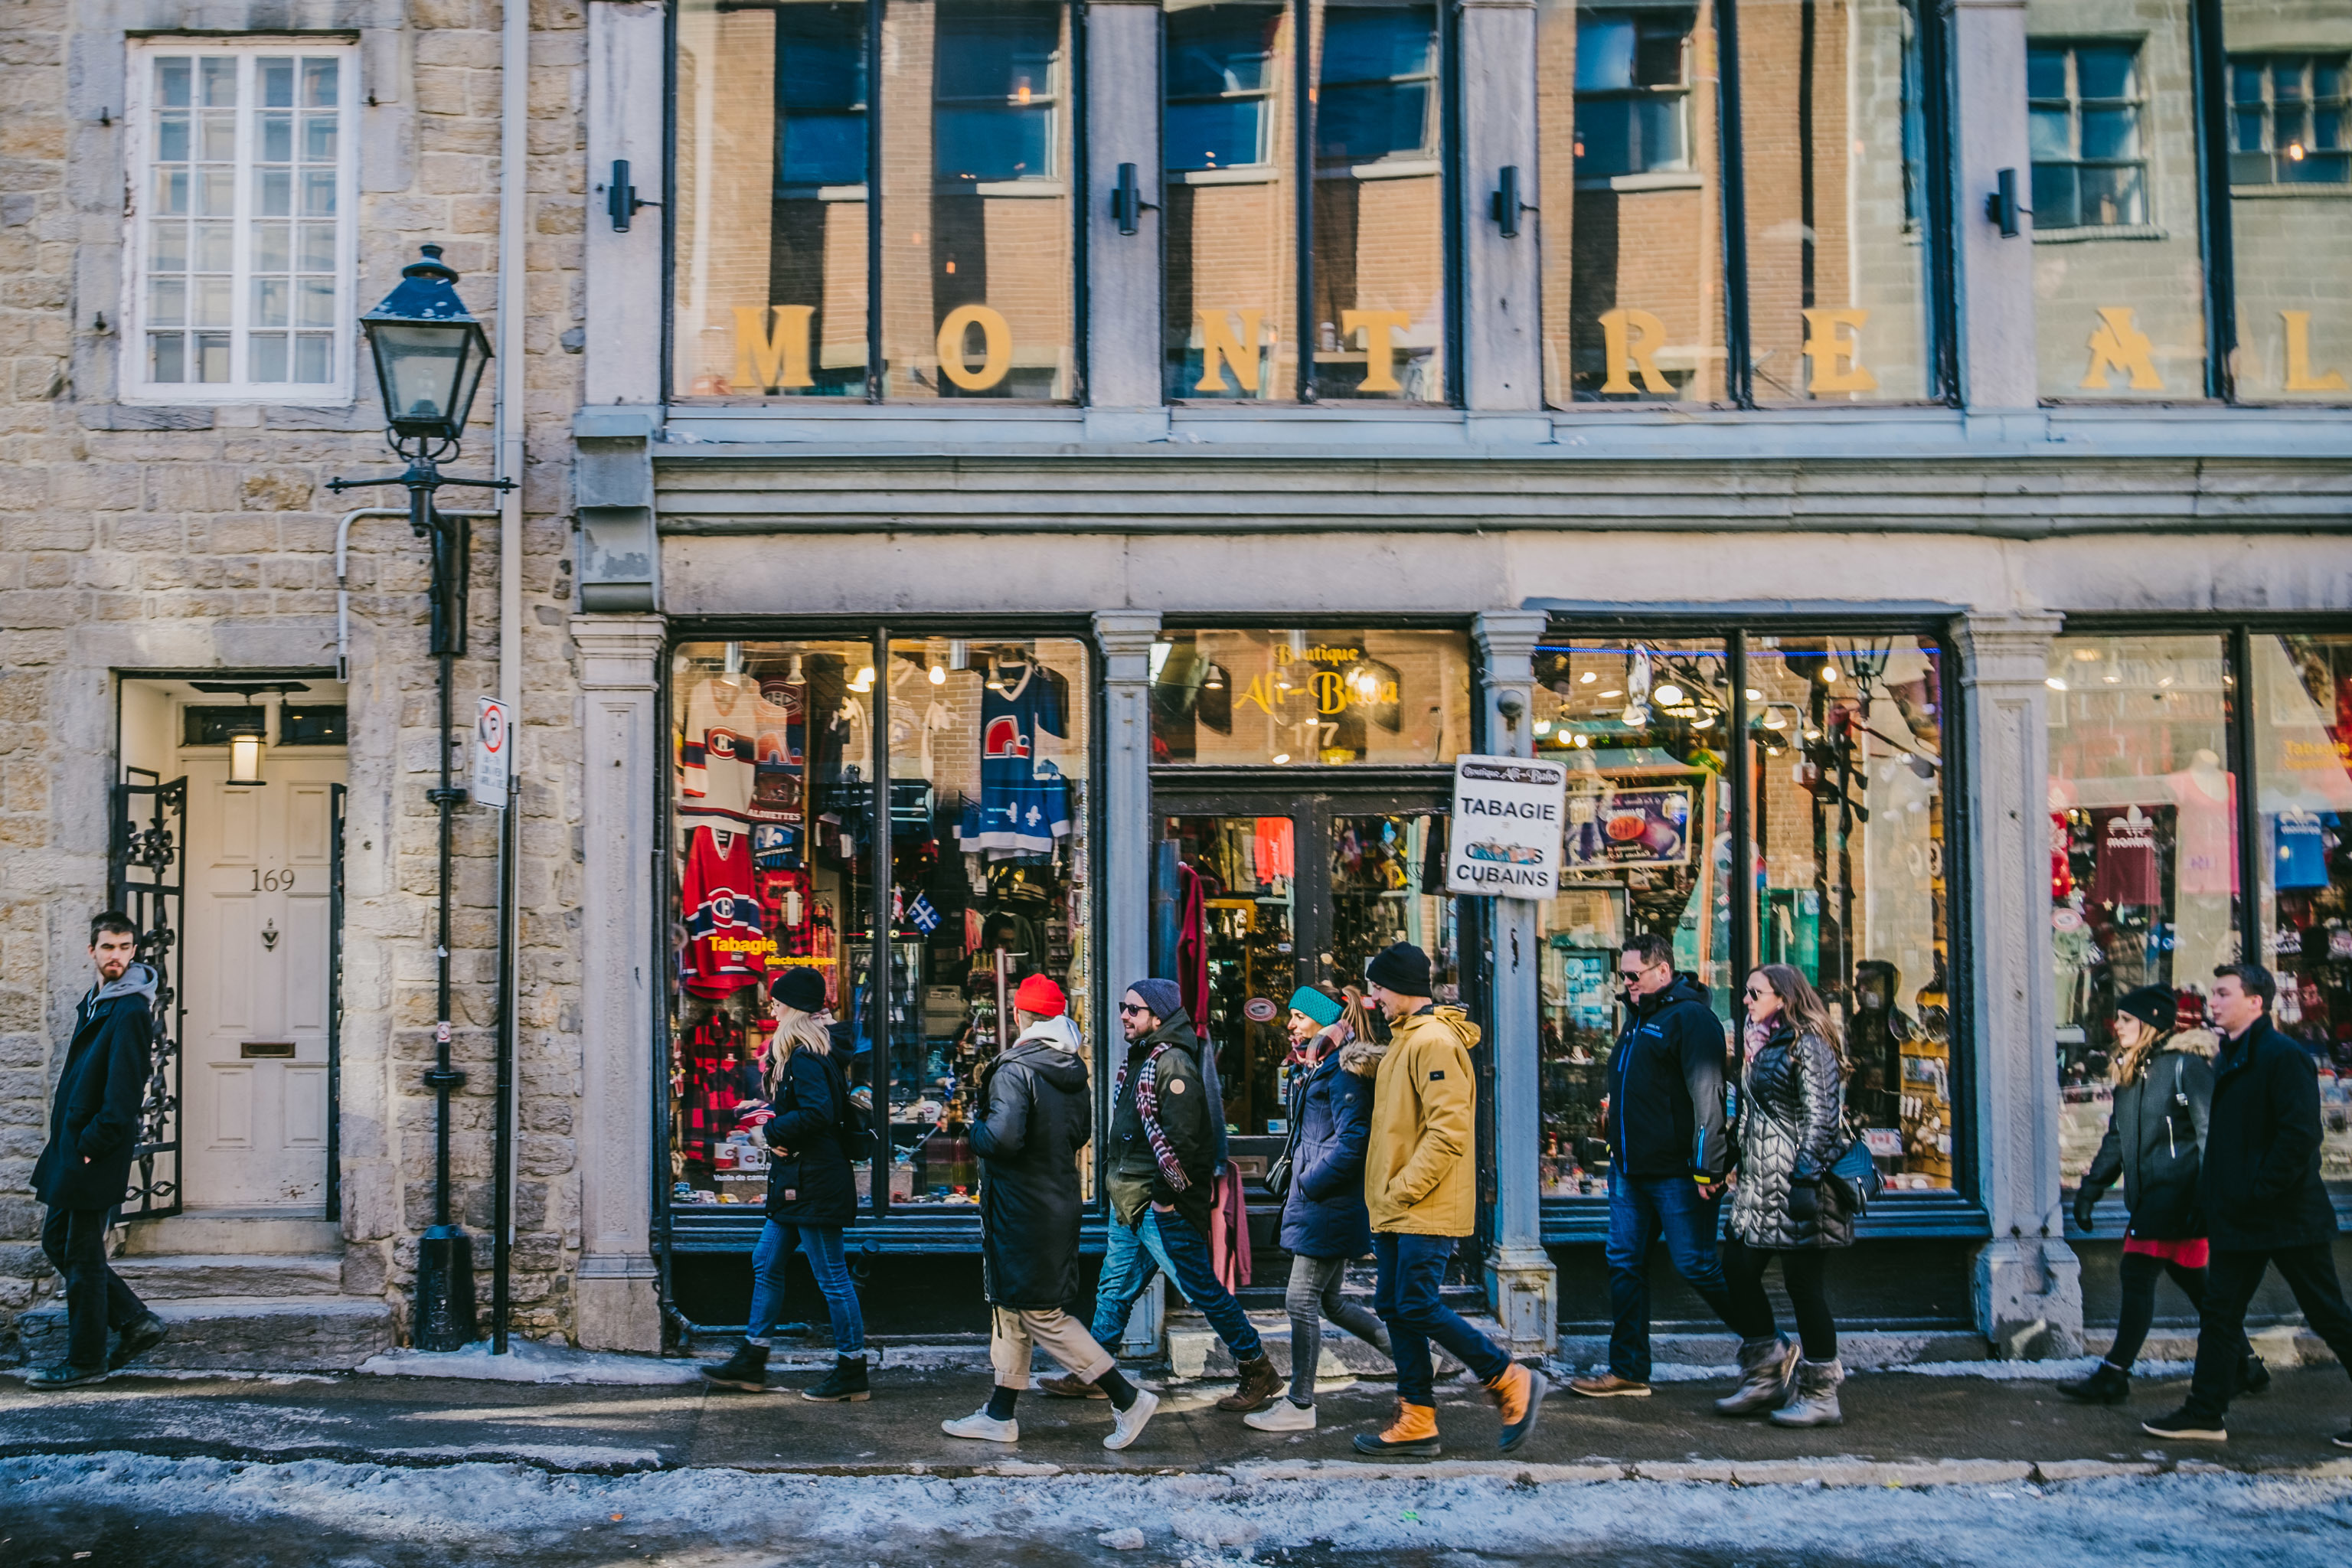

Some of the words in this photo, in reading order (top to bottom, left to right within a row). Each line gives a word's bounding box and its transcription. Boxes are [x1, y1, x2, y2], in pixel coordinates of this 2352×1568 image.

[1272, 644, 1359, 667] Boutique
[1289, 722, 1340, 747] 177
[1461, 797, 1556, 822] TABAGIE
[251, 869, 294, 892] 169
[1456, 864, 1549, 887] CUBAINS
[708, 936, 778, 956] Tabagie
